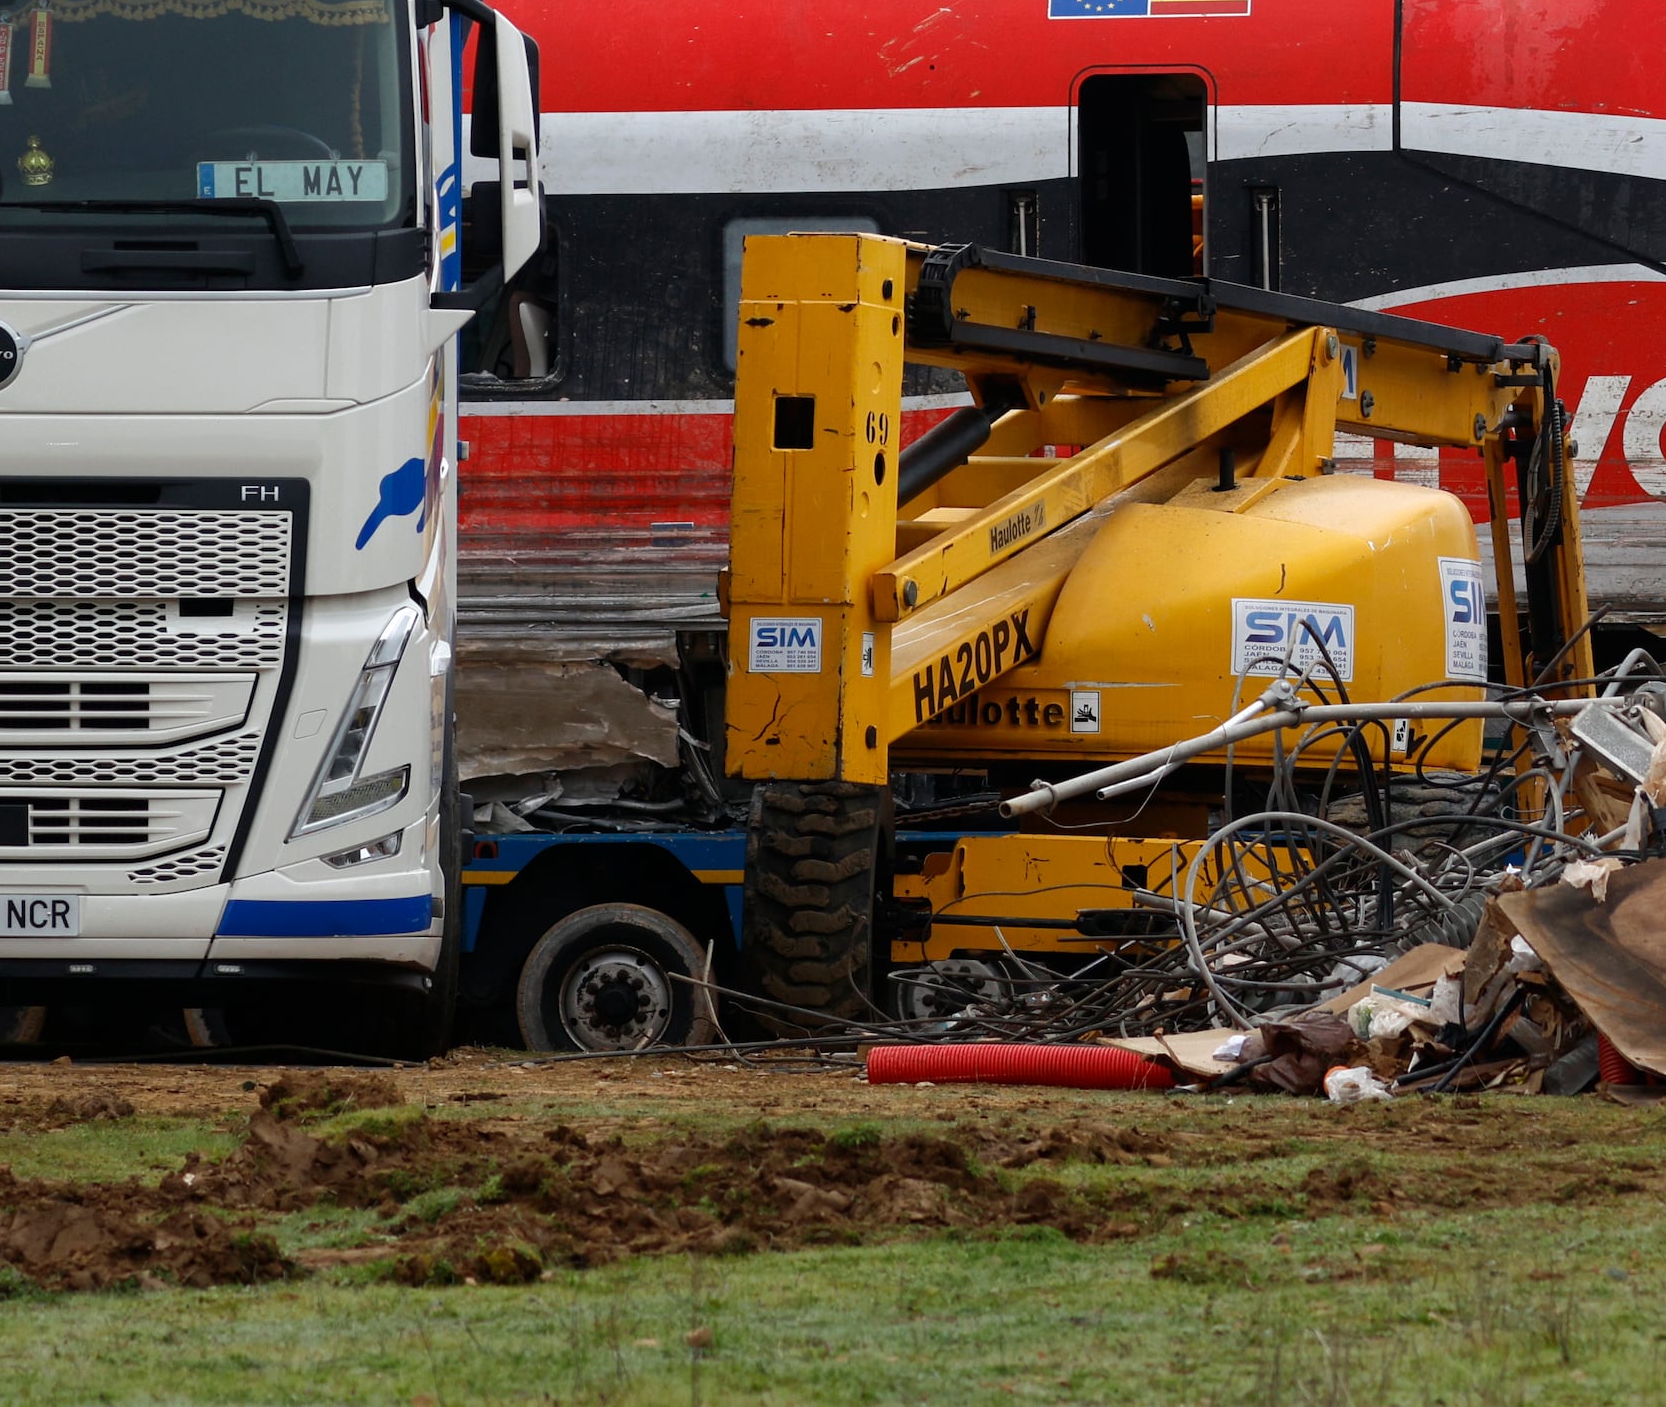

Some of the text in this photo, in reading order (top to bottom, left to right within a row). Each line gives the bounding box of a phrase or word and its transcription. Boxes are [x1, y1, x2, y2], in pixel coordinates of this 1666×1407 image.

[235, 166, 363, 197] EL MAY
[866, 410, 888, 445] 69
[241, 485, 279, 501] FH
[990, 513, 1031, 552] Haulotte
[757, 627, 816, 647] SIM
[913, 609, 1034, 724] HA20PX
[7, 899, 70, 929] NCR
